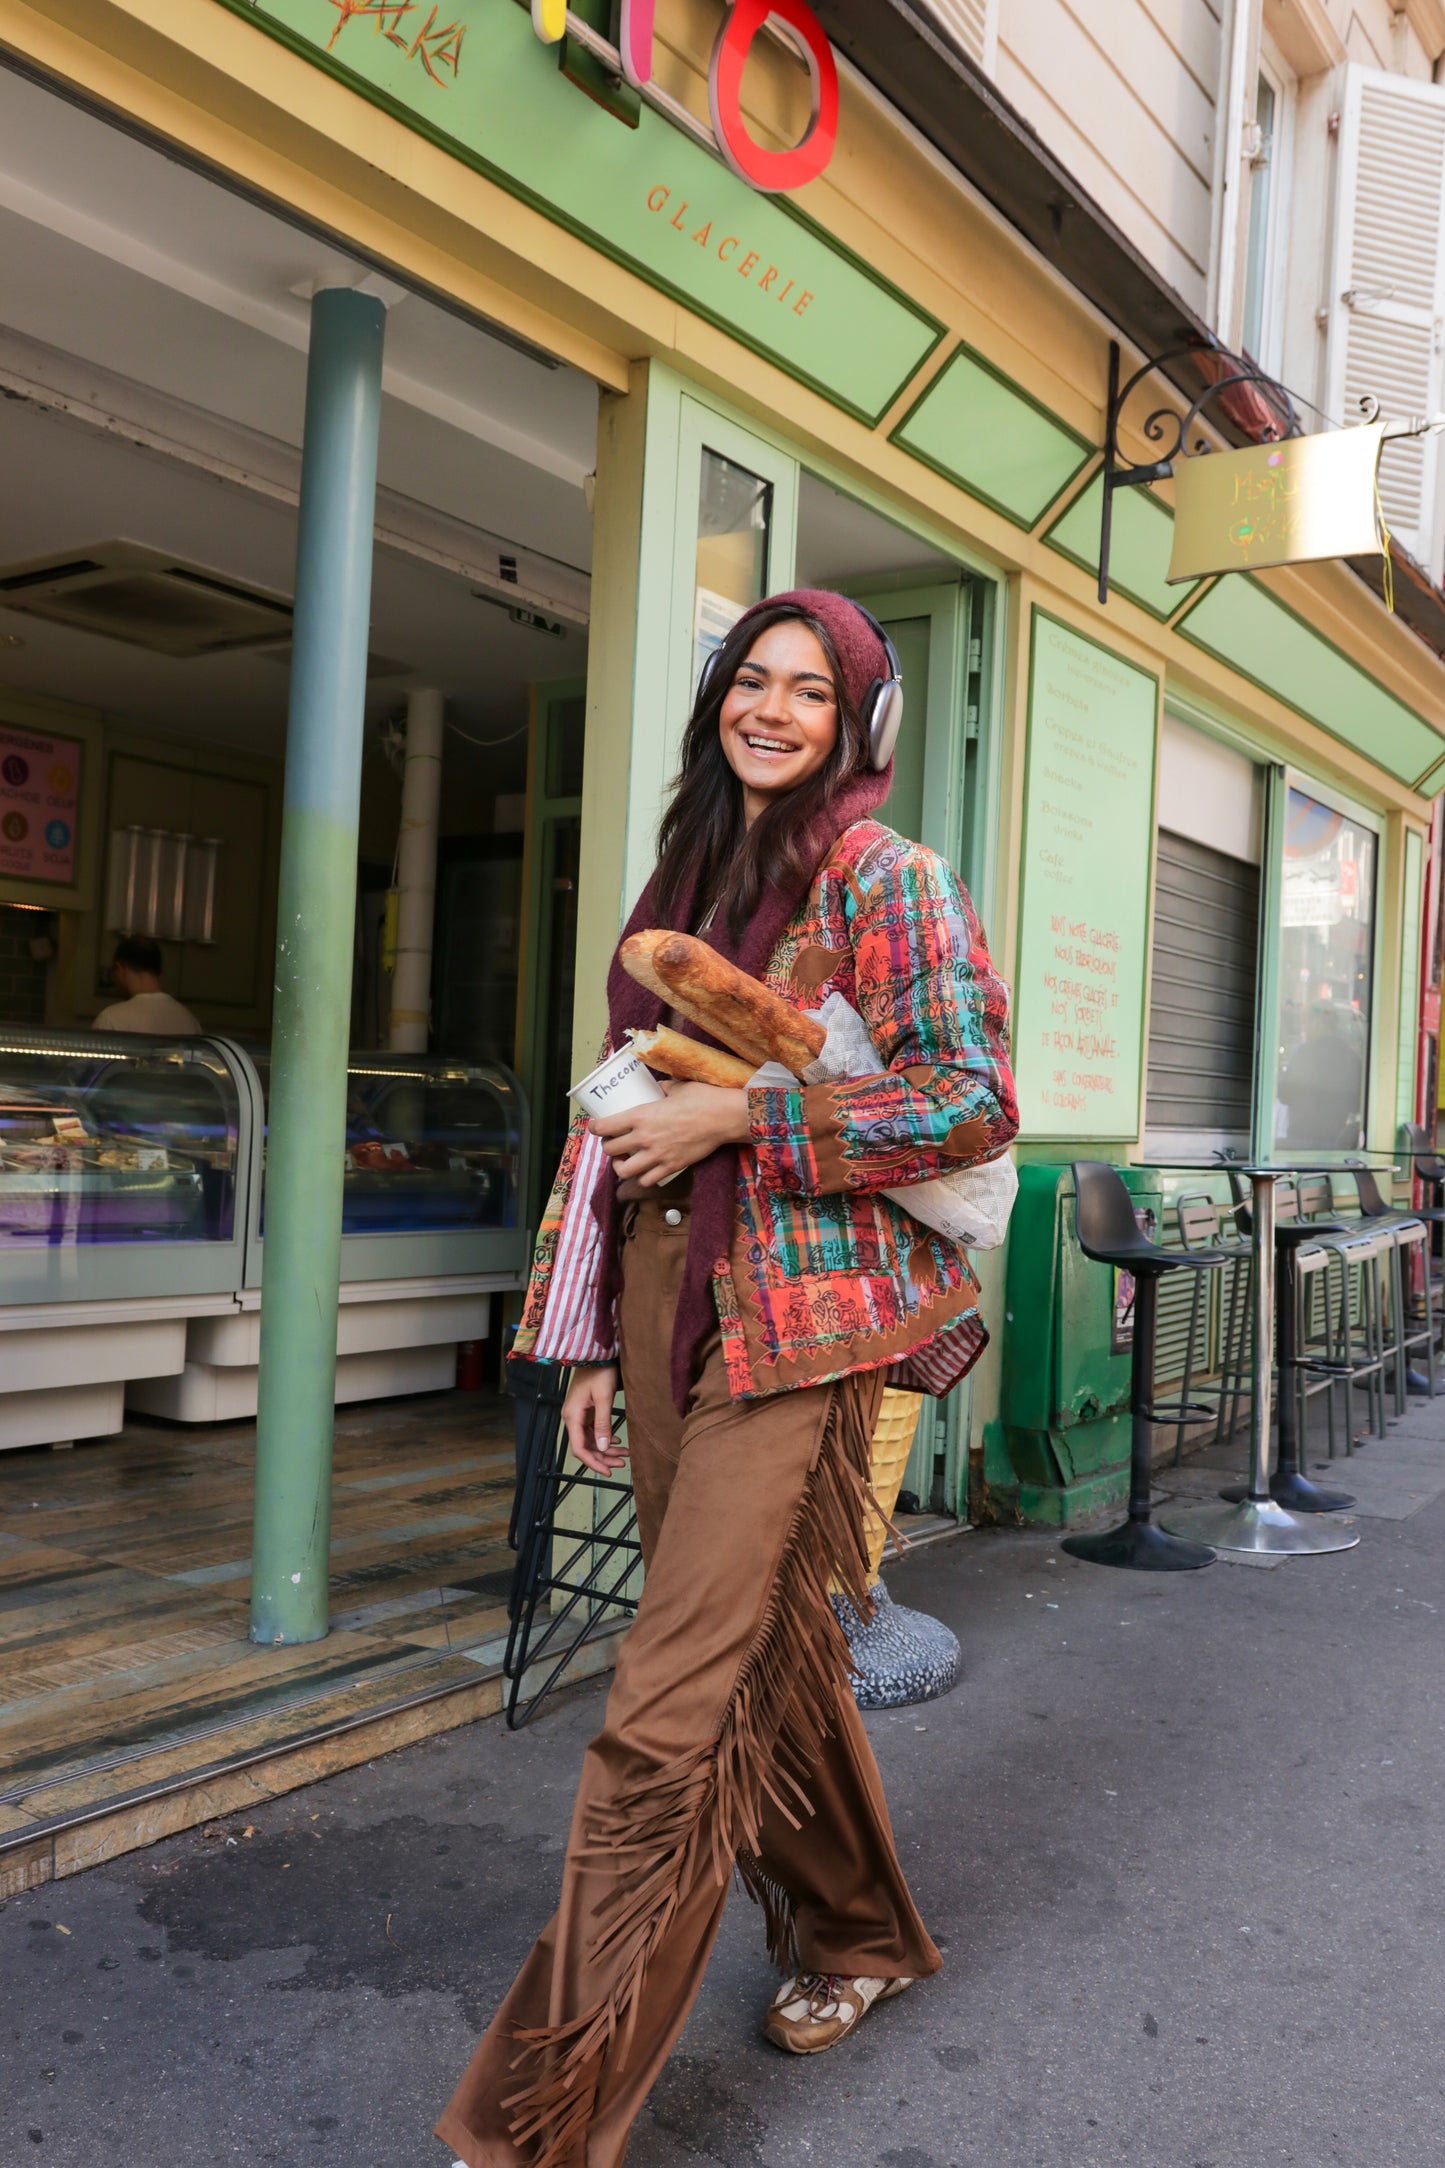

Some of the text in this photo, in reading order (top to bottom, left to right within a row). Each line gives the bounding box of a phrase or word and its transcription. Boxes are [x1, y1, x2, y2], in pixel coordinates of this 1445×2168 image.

[647, 184, 814, 317] GLACERIE
[1041, 800, 1093, 829] Boissons
[1053, 825, 1083, 841] drinks
[1051, 1000, 1068, 1024] NOS
[589, 1059, 641, 1100] Thecorn
